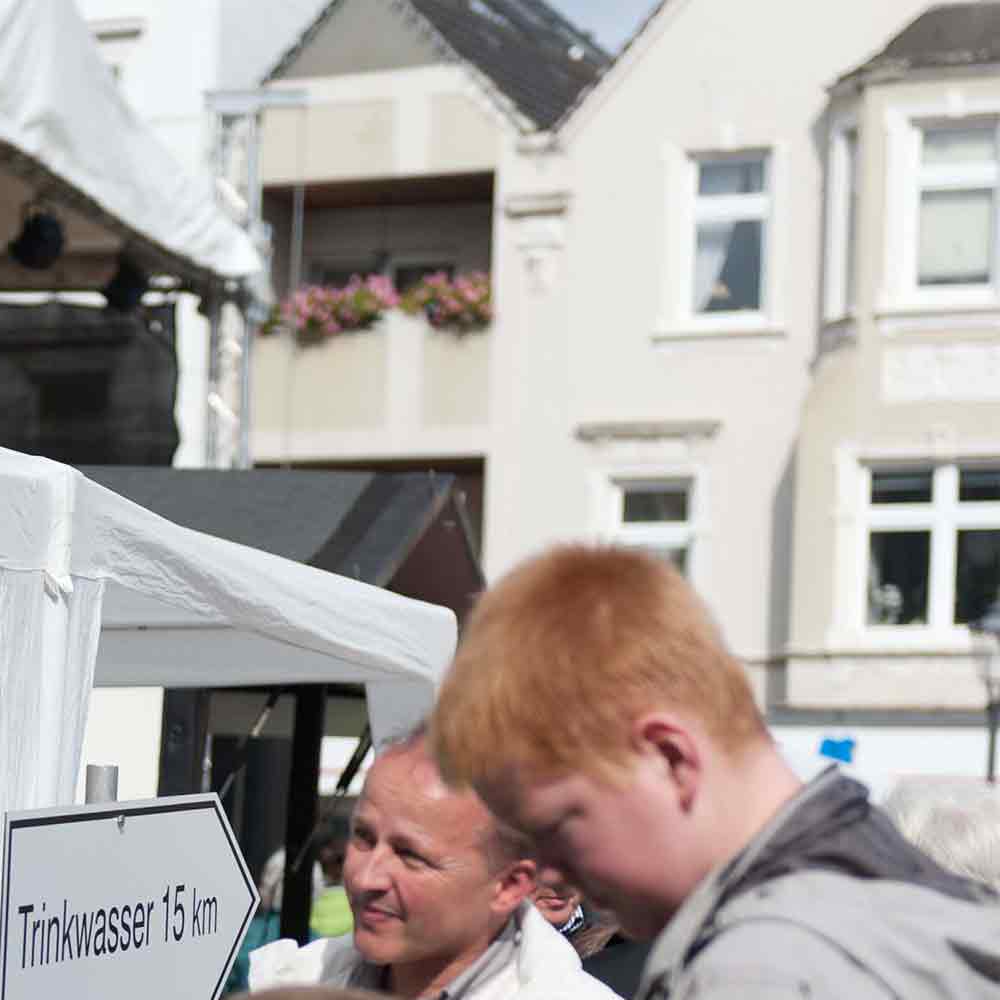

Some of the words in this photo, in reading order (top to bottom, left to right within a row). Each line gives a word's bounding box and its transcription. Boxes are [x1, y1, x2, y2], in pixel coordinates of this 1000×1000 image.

[18, 899, 154, 968] Trinkwasser
[162, 885, 185, 942] 15
[192, 888, 218, 937] km
